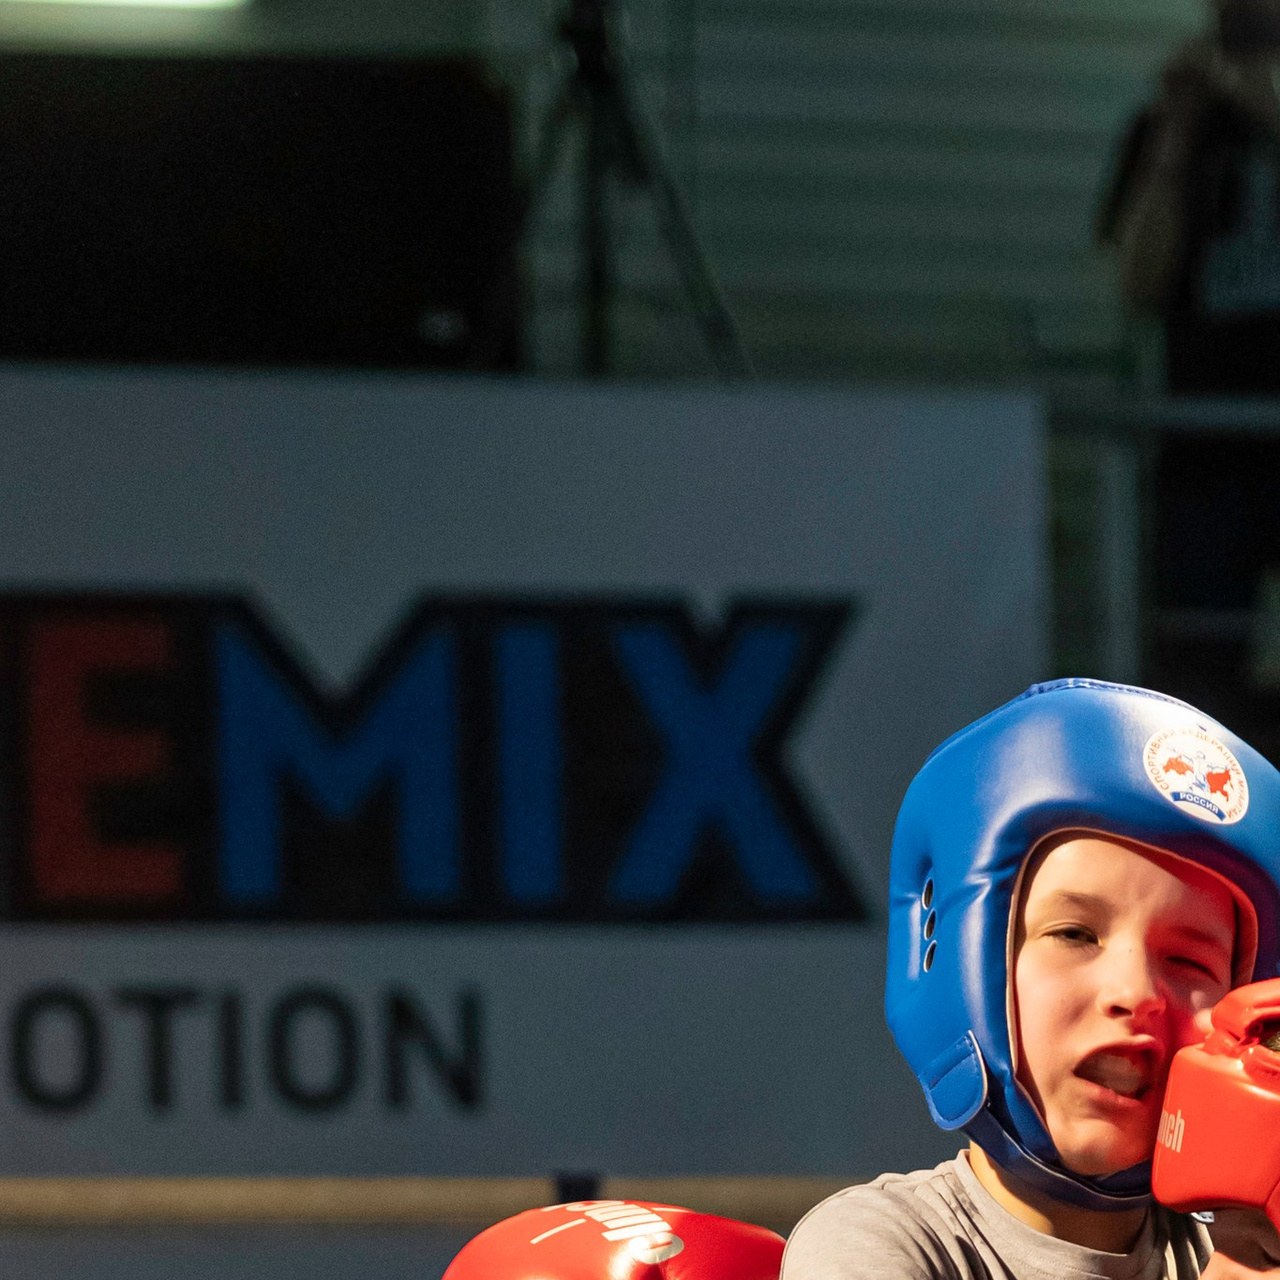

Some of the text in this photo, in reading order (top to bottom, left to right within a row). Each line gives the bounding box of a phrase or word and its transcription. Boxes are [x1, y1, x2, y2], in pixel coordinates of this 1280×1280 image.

[26, 612, 818, 908] EMIX
[1179, 791, 1219, 815] РОССИЯ
[12, 982, 486, 1116] OTION
